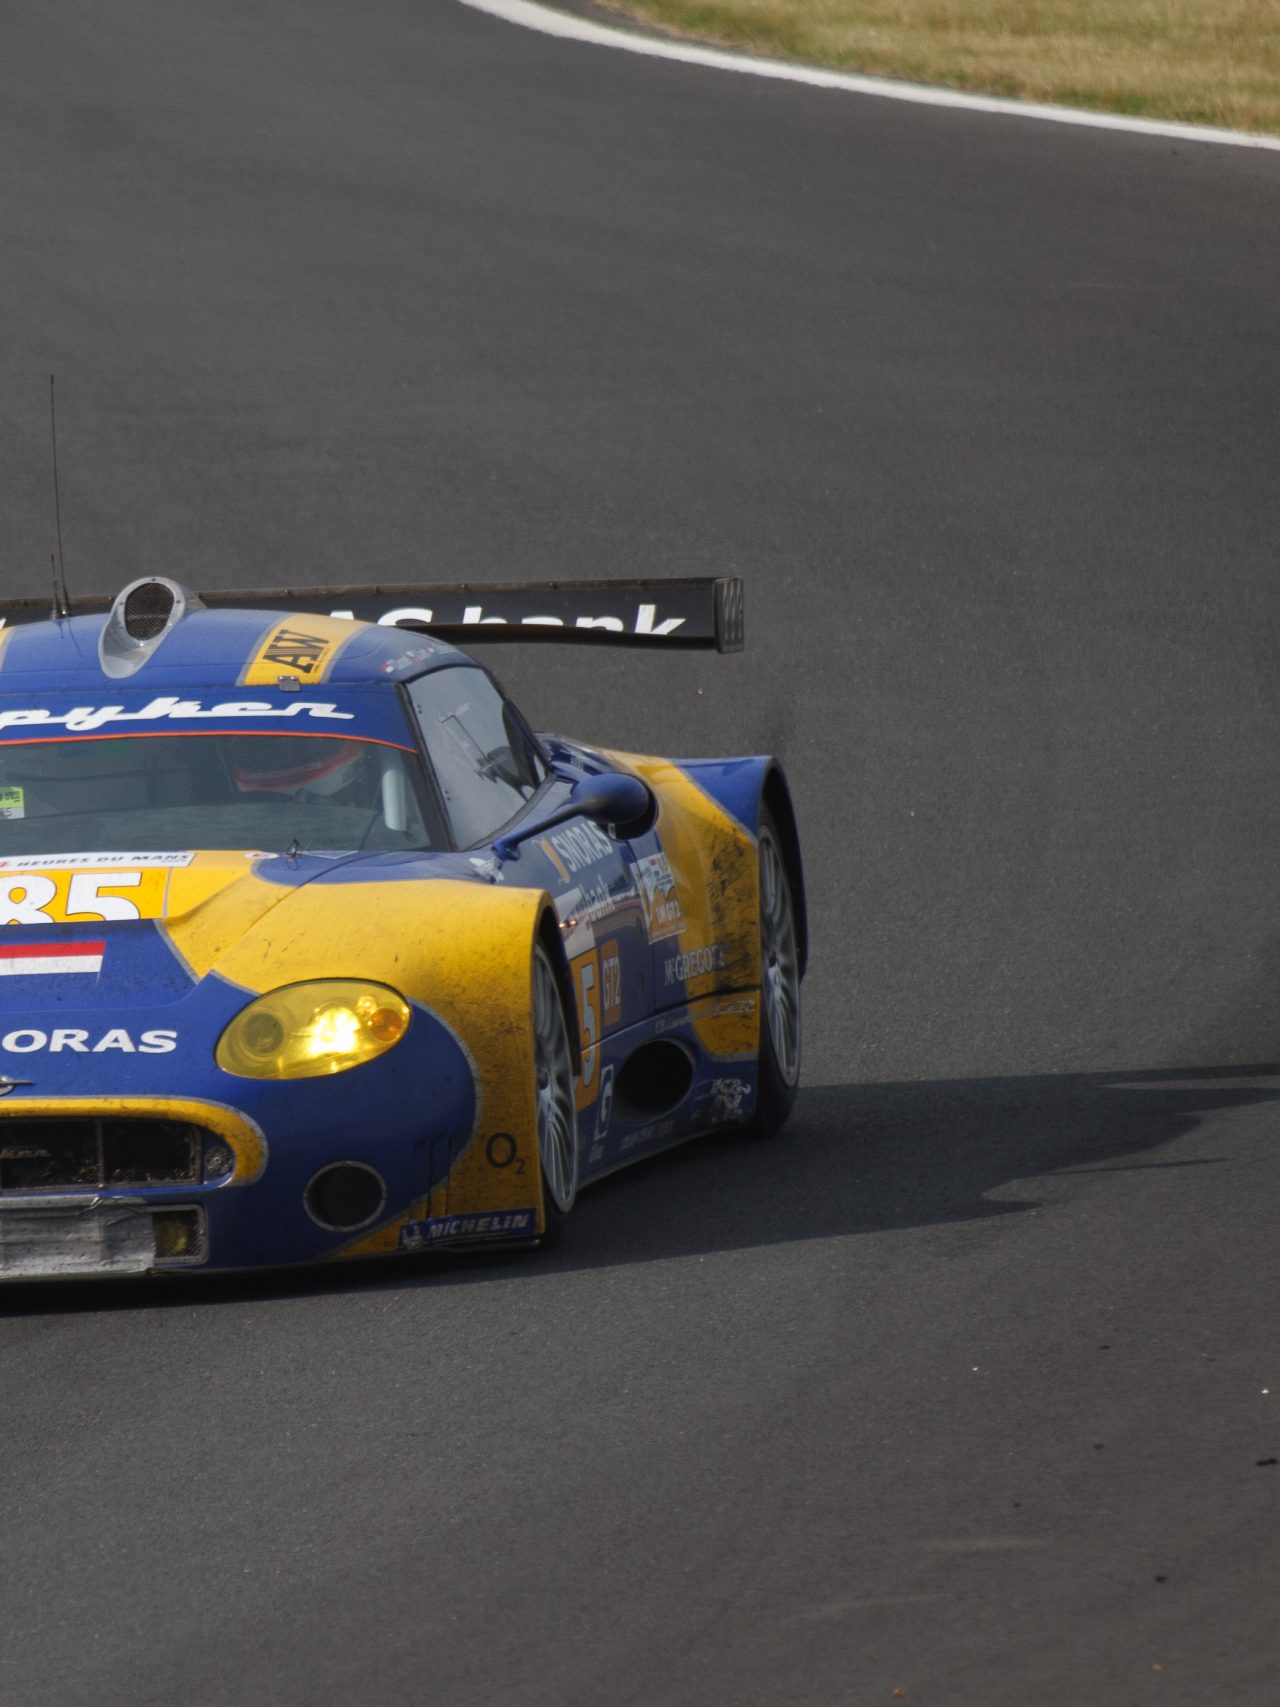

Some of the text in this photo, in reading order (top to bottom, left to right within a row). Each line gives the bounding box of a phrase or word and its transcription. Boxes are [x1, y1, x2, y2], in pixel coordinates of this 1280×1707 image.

[16, 857, 91, 867] HEURES
[95, 855, 123, 863] DU
[130, 853, 190, 862] MANS
[551, 820, 614, 873] SNORAS
[580, 962, 596, 1088] 5
[427, 1213, 529, 1239] MICHELIN
